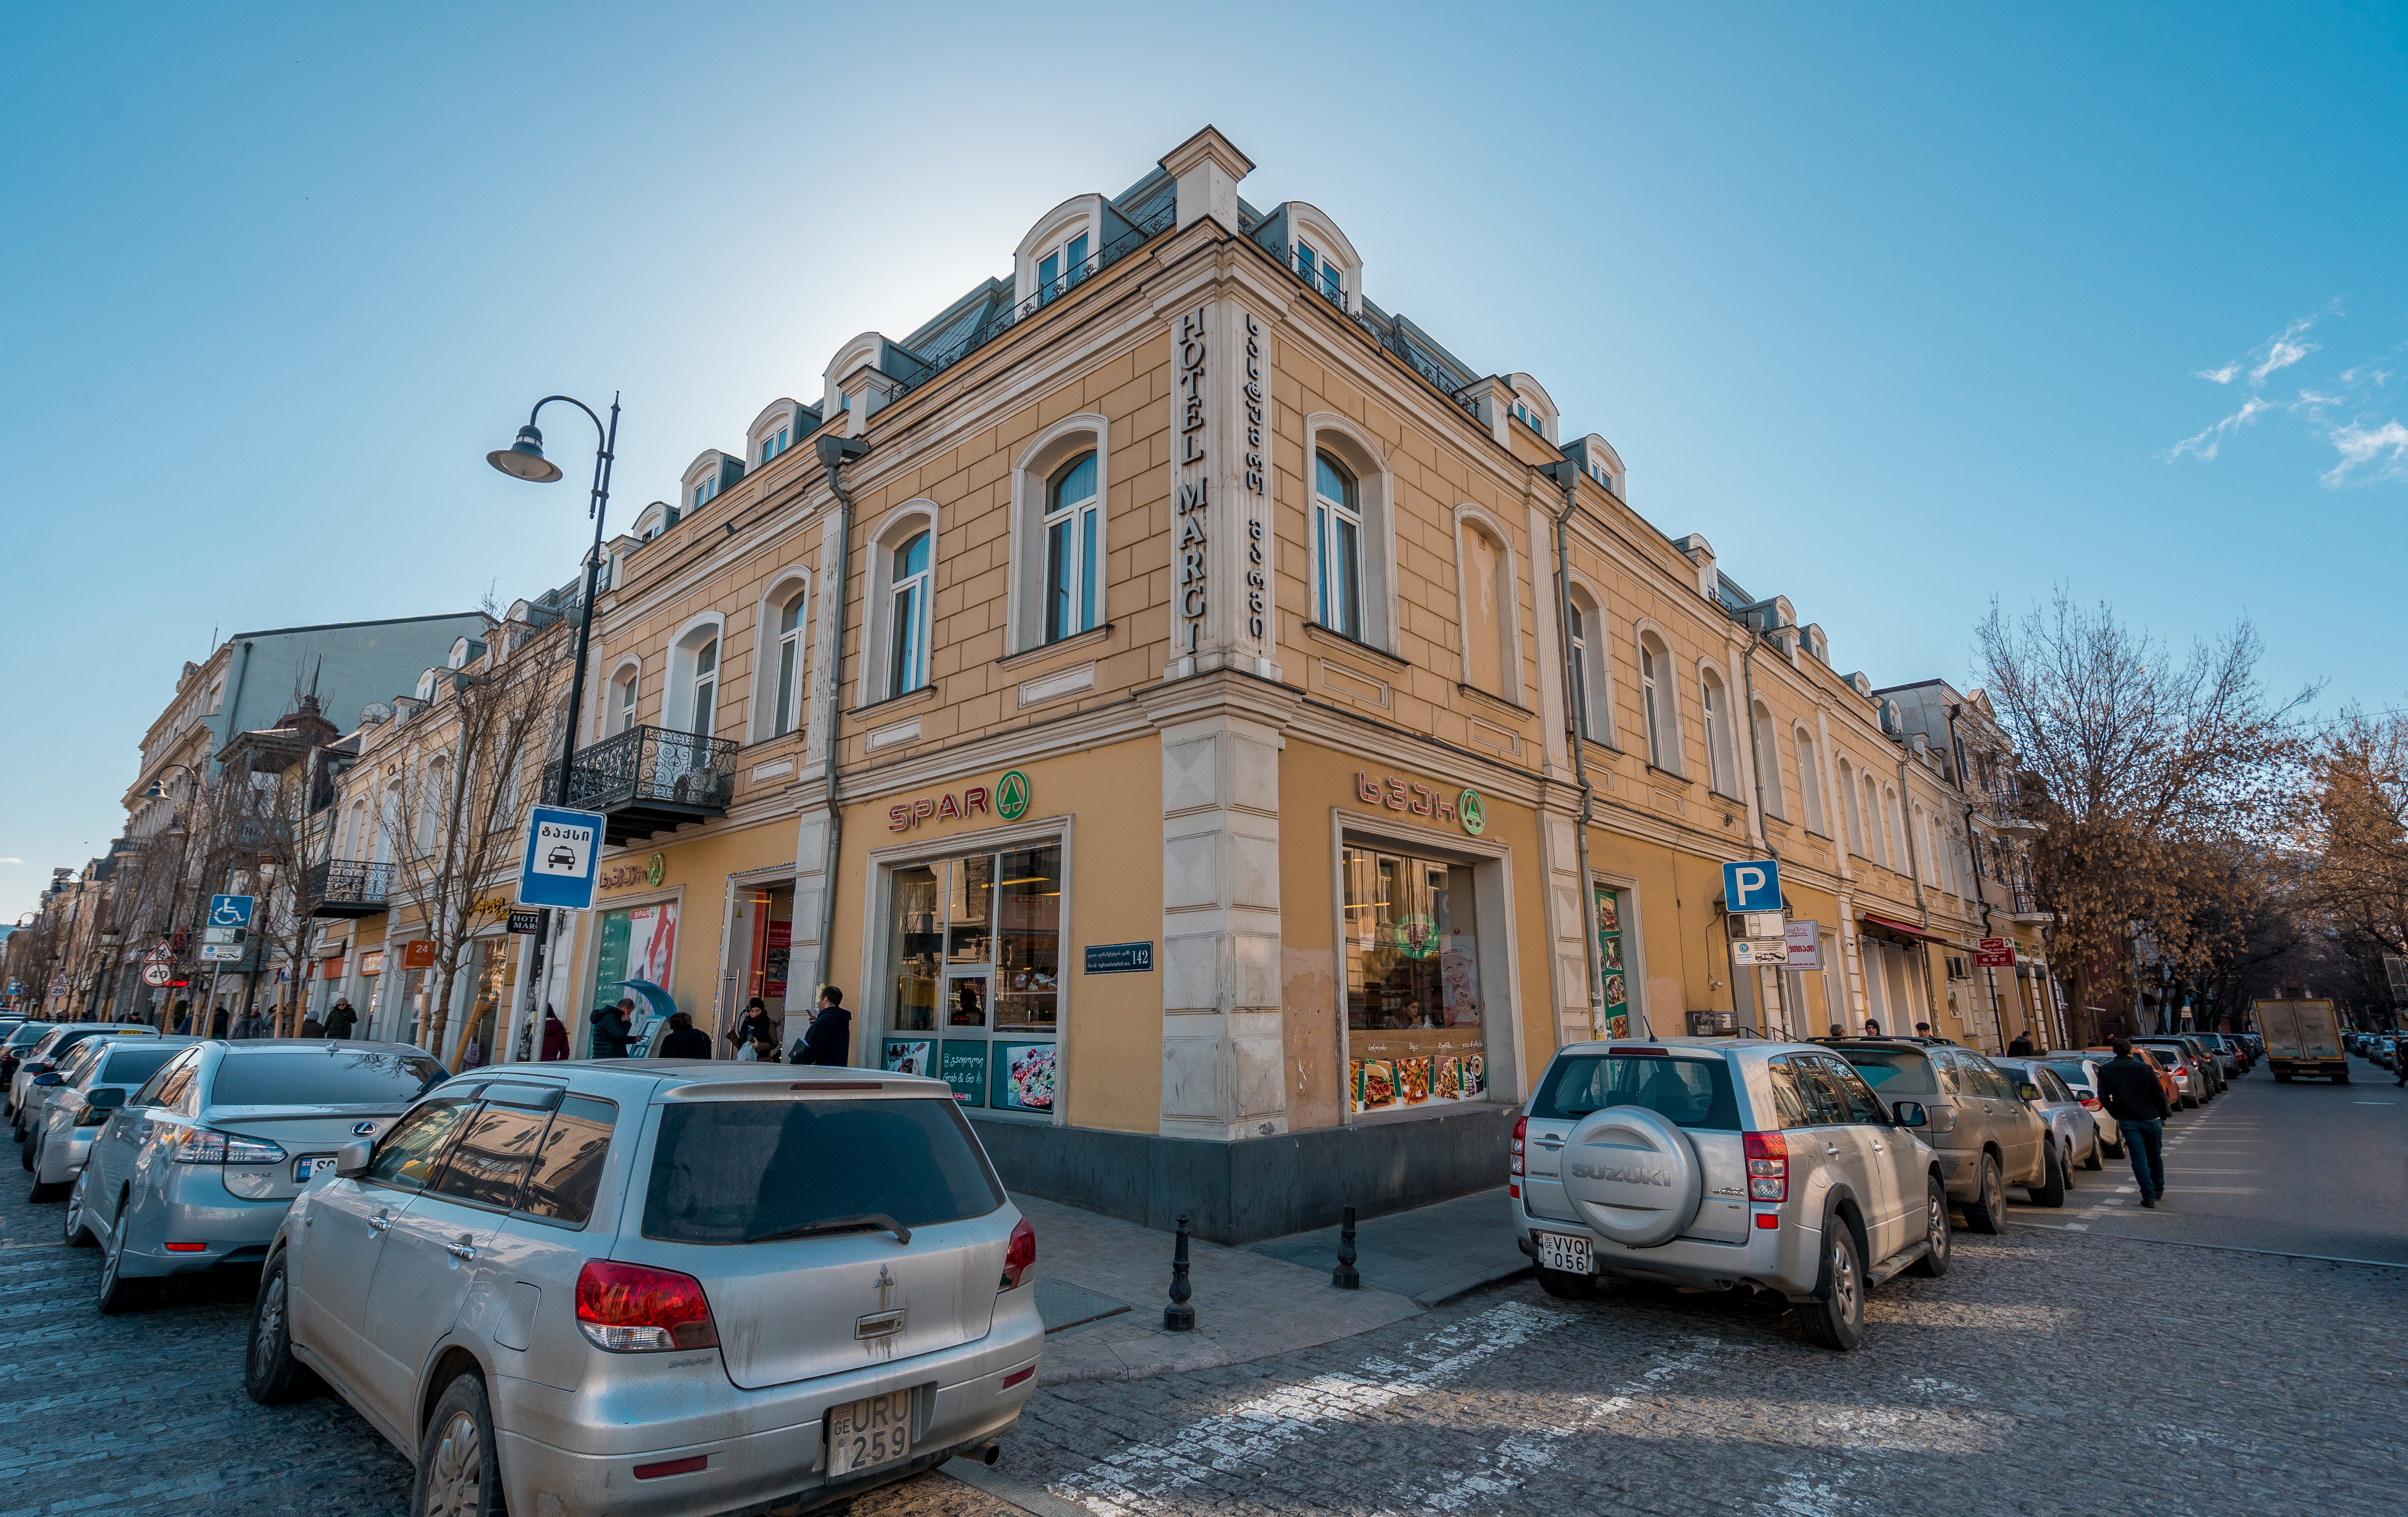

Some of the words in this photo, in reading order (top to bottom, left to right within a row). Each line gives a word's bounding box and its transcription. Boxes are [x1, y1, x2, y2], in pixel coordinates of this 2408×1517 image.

[1178, 307, 1204, 466] HOTEL
[1245, 313, 1266, 495] სასტუმრო
[1178, 476, 1207, 654] MARGI
[1247, 518, 1266, 638] მარგი
[1360, 770, 1455, 821] სპარ
[888, 786, 987, 832] SPAR
[542, 826, 589, 841] ტაქსი
[1735, 867, 1766, 905] P
[513, 915, 537, 923] HOT
[634, 909, 650, 918] SPAR
[416, 945, 428, 953] 24
[1132, 950, 1148, 965] 142
[149, 970, 168, 979] 40
[943, 1072, 957, 1083] Grab
[958, 1073, 964, 1082] &
[966, 1073, 974, 1083] Go
[1530, 1169, 1558, 1178] SUZUKI
[1571, 1162, 1671, 1187] SUZUKI
[1711, 1189, 1745, 1197] VITARA
[1544, 1241, 1553, 1249] GE
[1553, 1236, 1585, 1256] VVQ
[1555, 1253, 1584, 1271] 056
[852, 1391, 909, 1433] URU
[834, 1418, 851, 1435] GE
[851, 1426, 905, 1468] 259
